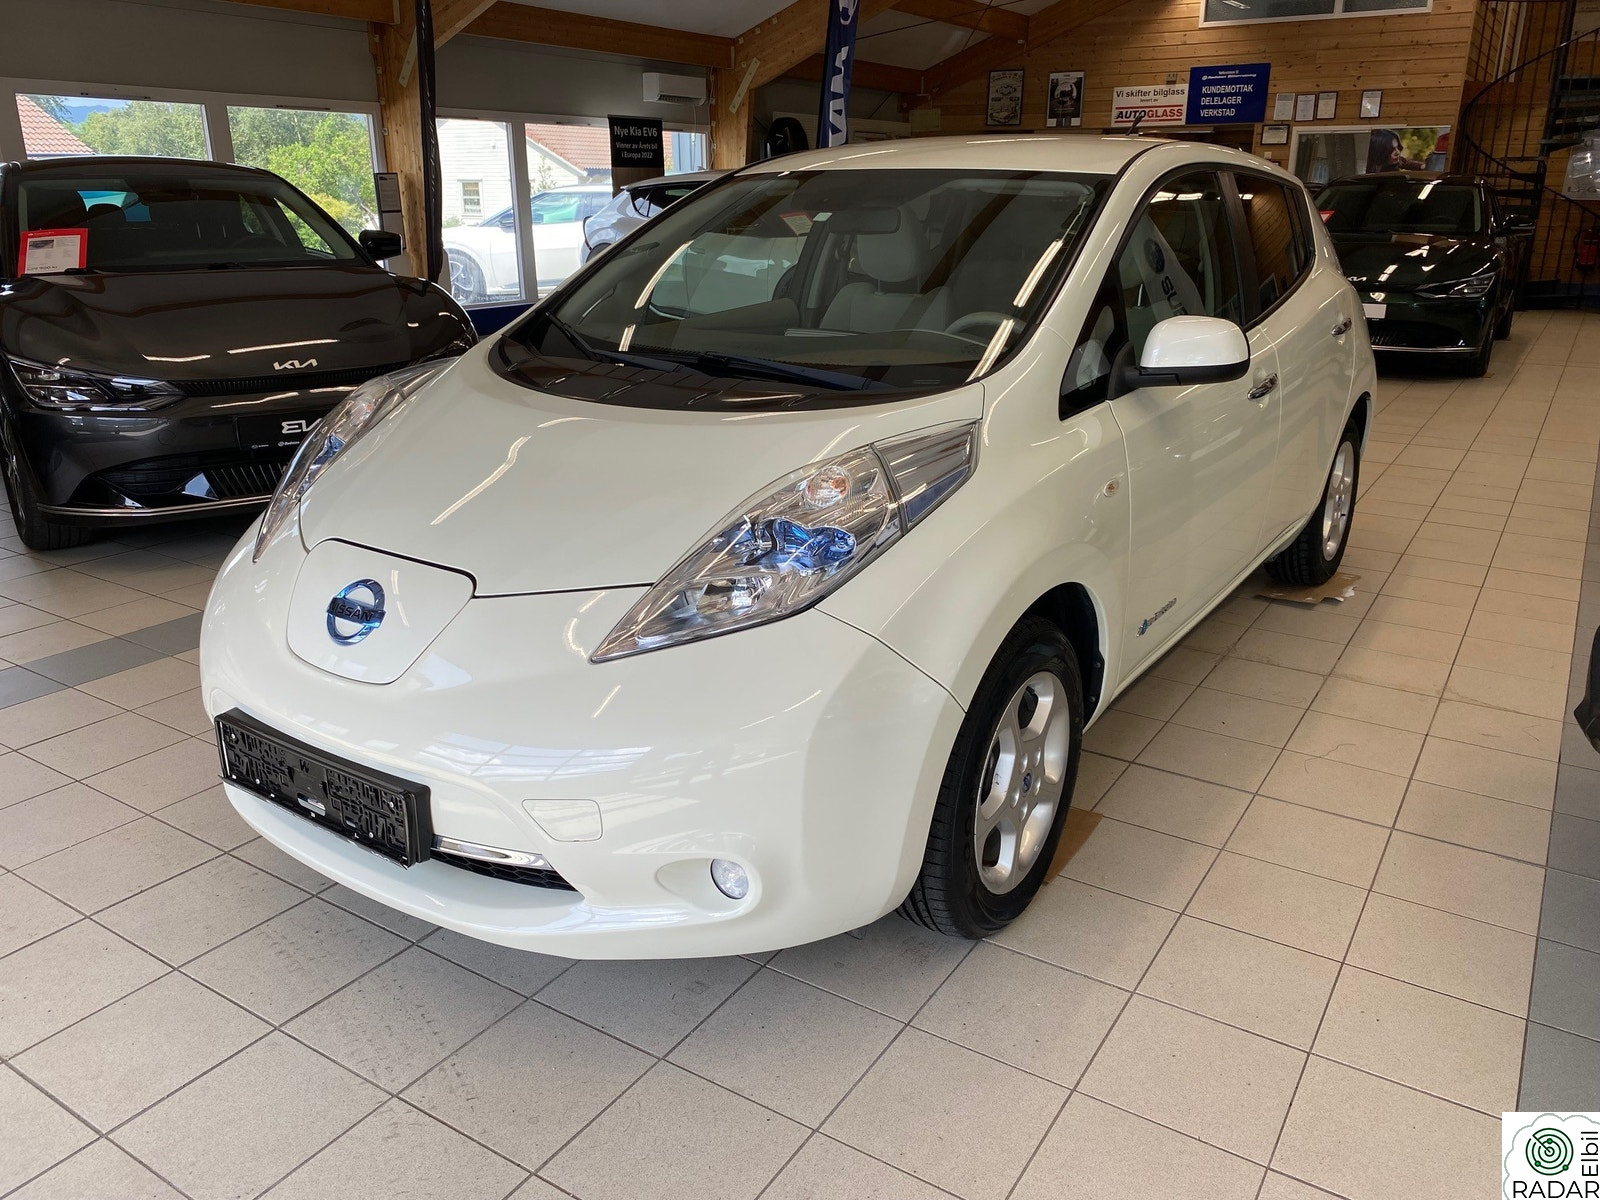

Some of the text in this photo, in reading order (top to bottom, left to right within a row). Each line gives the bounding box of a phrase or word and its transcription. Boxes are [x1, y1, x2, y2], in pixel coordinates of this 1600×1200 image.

[1116, 88, 1185, 98] Vi skifter bilglass
[1202, 84, 1254, 94] KUNDEMOTTAK
[1201, 96, 1242, 105] DELELAGER
[1115, 108, 1183, 119] AUTOGLASS
[1200, 108, 1236, 117] VERKSTAD
[614, 125, 658, 138] Nye Kia EV6
[616, 141, 631, 149] Vinner
[639, 141, 651, 150] Årets
[624, 151, 641, 160] Europa
[273, 358, 318, 371] KIA
[329, 600, 375, 622] NISSAN
